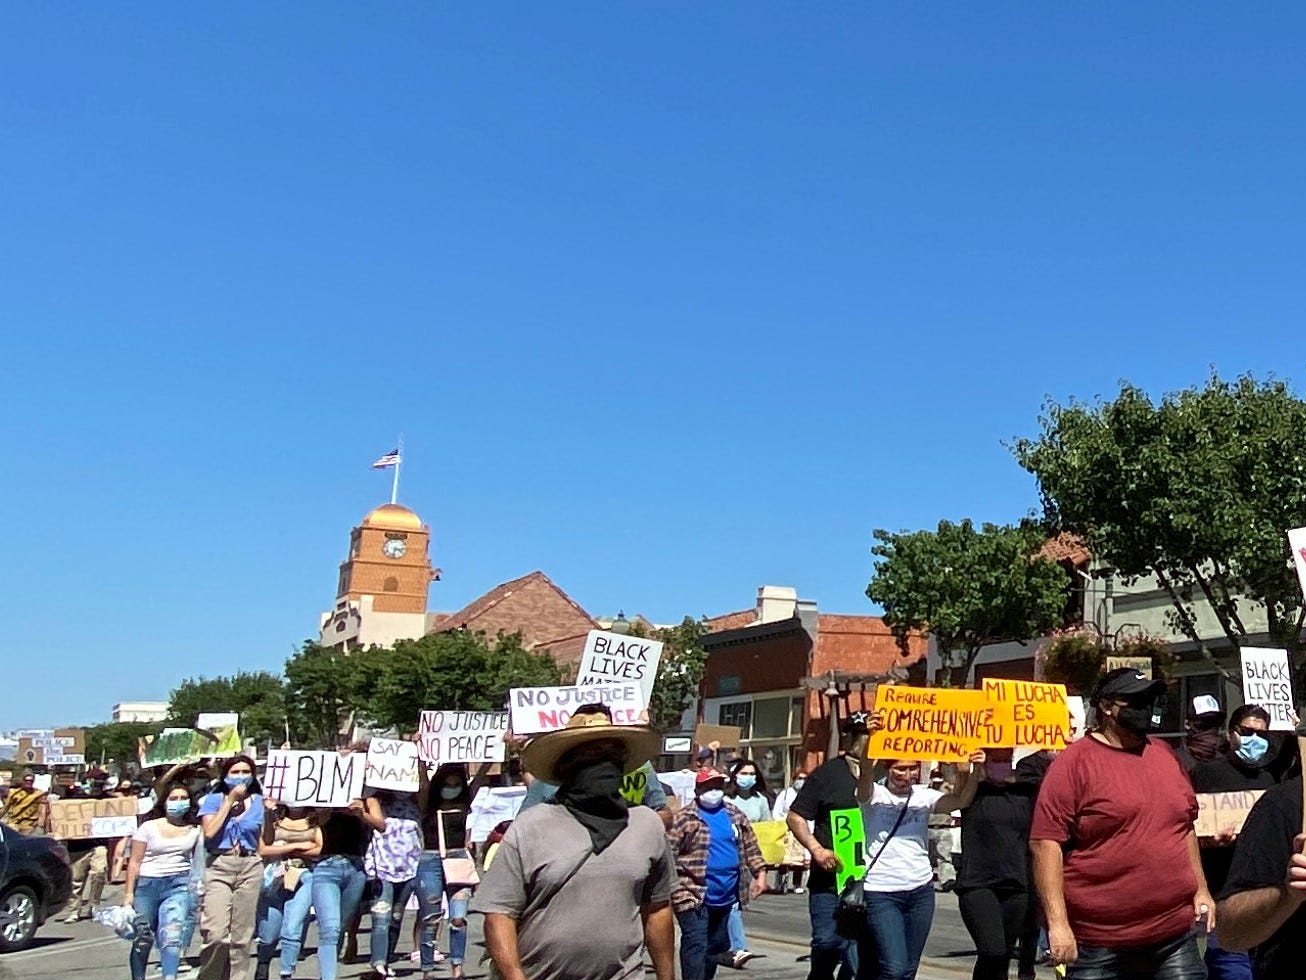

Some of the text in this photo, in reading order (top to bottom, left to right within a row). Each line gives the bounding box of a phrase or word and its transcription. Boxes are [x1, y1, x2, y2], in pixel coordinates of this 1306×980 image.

[593, 637, 650, 662] BLACK
[590, 656, 646, 680] LIVES
[1245, 660, 1291, 681] BLACK
[517, 686, 636, 708] NO JUSTICE
[986, 681, 1066, 705] MI LUCHA
[1248, 683, 1290, 702] LIVES
[421, 712, 508, 733] NO JUSTICE
[1013, 704, 1035, 721] ES
[1262, 702, 1294, 722] TTER
[986, 724, 1067, 745] TU LUCHA
[373, 741, 404, 756] SAY
[420, 735, 496, 761] NO PEACE
[883, 737, 968, 757] REPORTING
